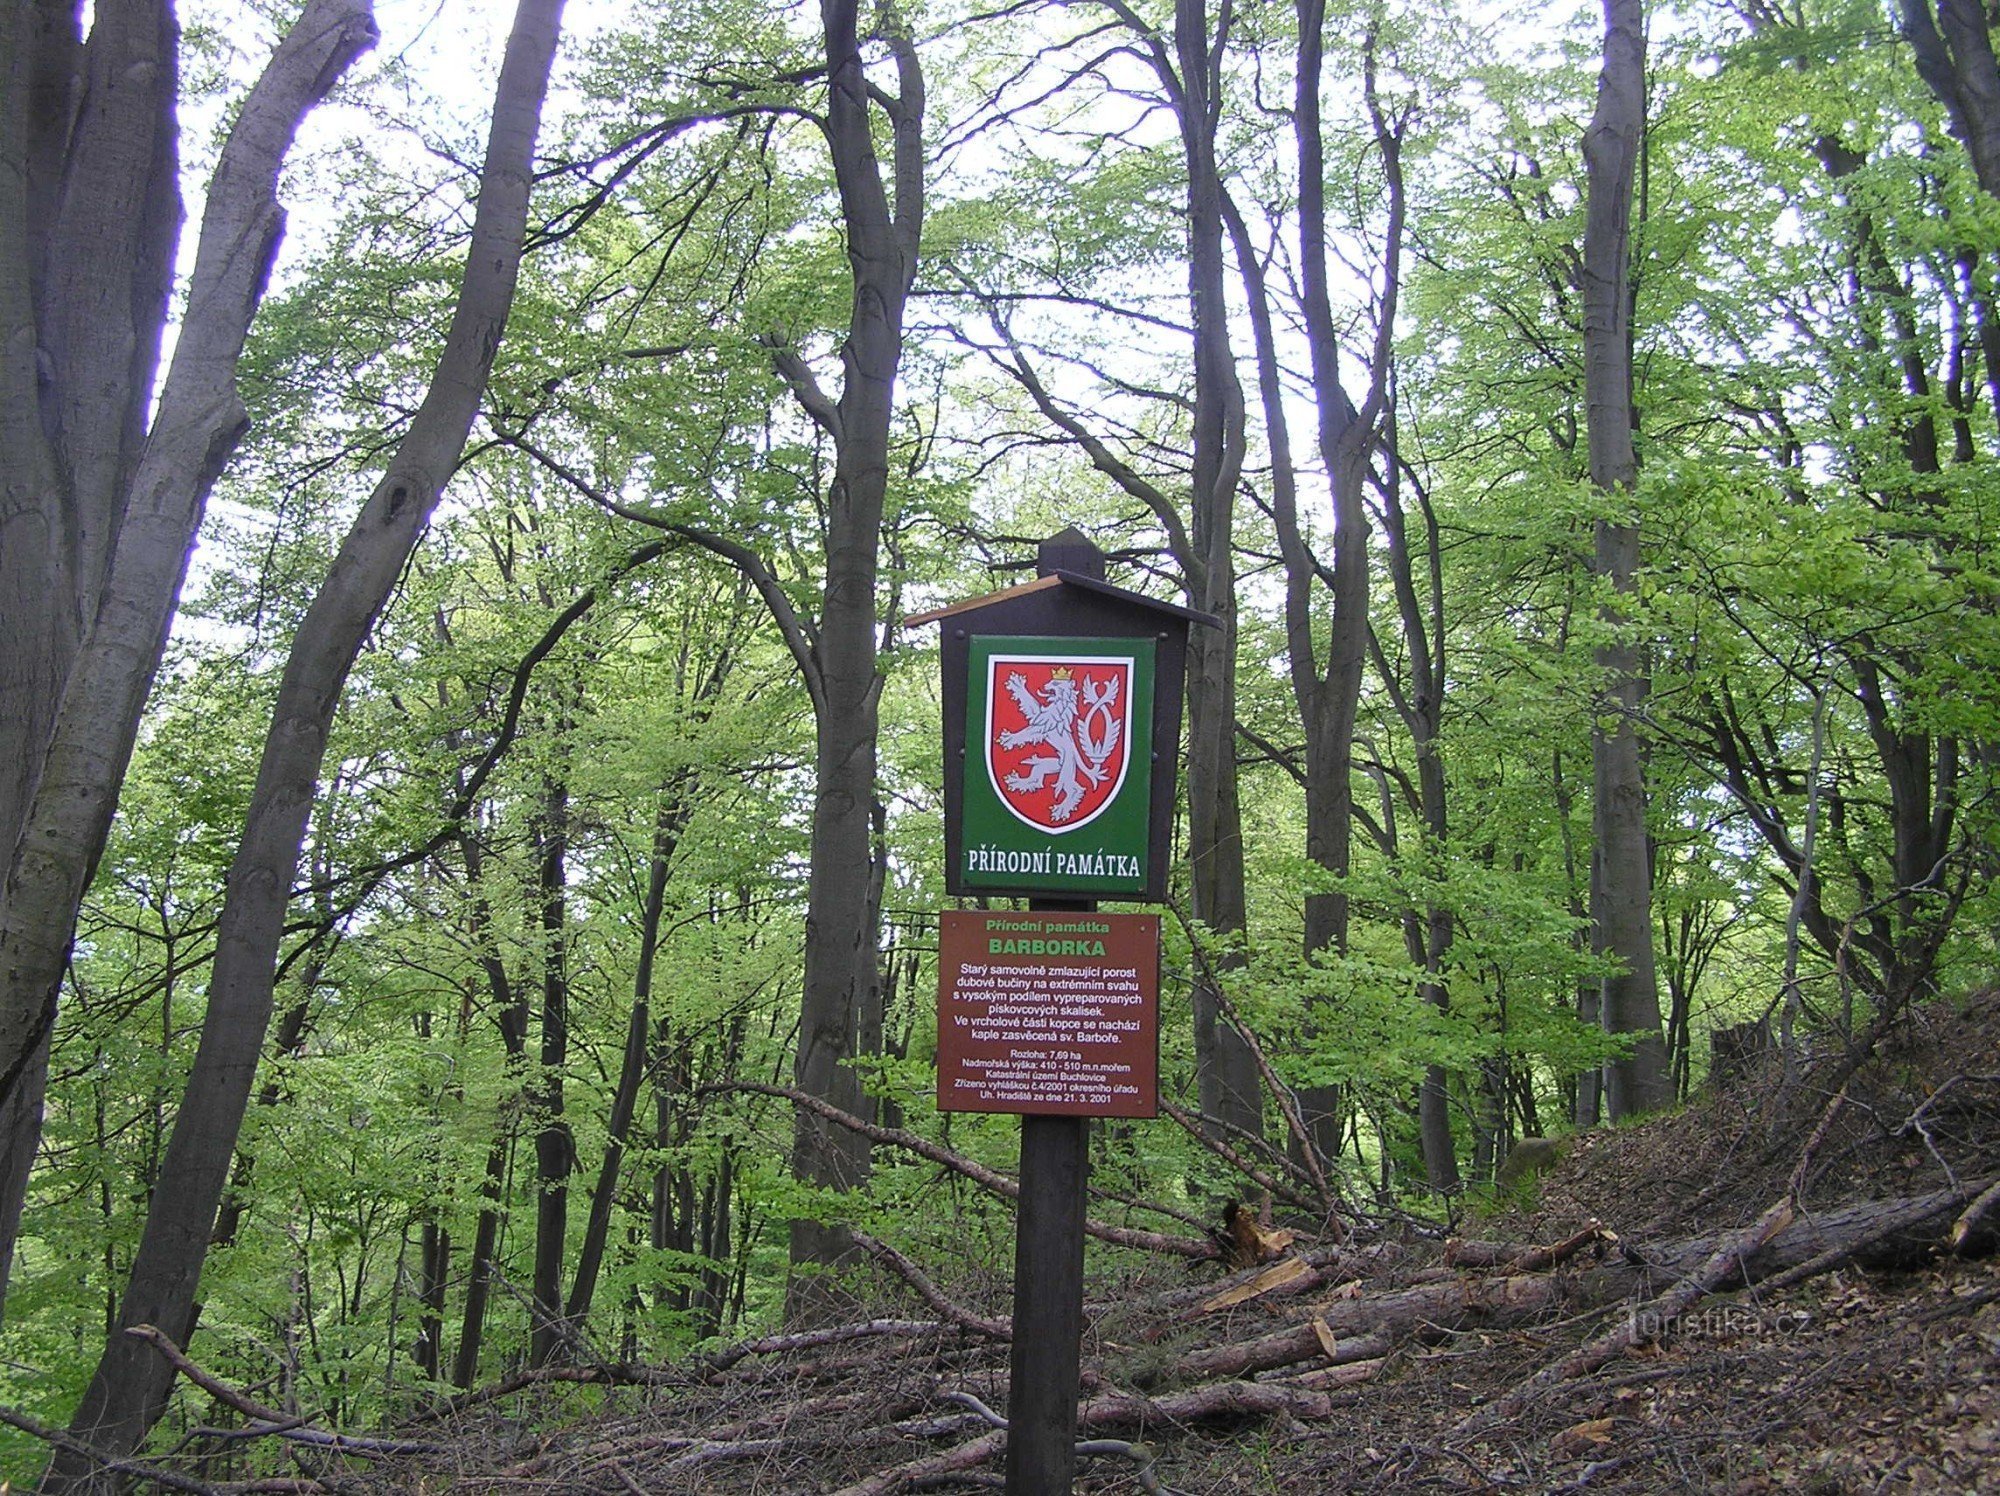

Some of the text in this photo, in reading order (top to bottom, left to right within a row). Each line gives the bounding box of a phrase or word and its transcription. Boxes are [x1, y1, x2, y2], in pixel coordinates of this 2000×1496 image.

[968, 843, 1141, 878] PŘÍRODNÍ PAMÁTKA
[986, 920, 1110, 934] Přírodní památka
[988, 938, 1106, 957] BARBORKA
[960, 963, 1136, 979] Starý samovolně zmlazující porost
[957, 977, 1139, 991] dubové bučiny na extrémním svahu
[953, 990, 1142, 1006] s vysokým podílem vypreparovaných
[988, 1003, 1106, 1017] pískovcových skalisek.
[954, 1015, 968, 1026] Ve
[971, 1016, 1020, 1027] vrcholové
[1049, 1018, 1081, 1030] kopce
[1083, 1021, 1097, 1029] se
[1098, 1019, 1140, 1031] nachází
[971, 1028, 1122, 1044] kaple zasvěcená sv. Barboře.
[1010, 1049, 1082, 1060] Rozloha: 7,69 ha
[962, 1058, 1010, 1069] Nadmořská
[1012, 1060, 1038, 1070] výška:
[1040, 1061, 1057, 1070] 410
[1064, 1062, 1081, 1071] 510
[985, 1070, 1107, 1082] Katastrální území Buchlovice
[954, 1078, 987, 1088] Zřízeno
[988, 1080, 1030, 1091] vyhláškou
[1069, 1083, 1112, 1093] okresního
[1113, 1084, 1139, 1094] úřadu
[980, 1090, 995, 1099] Uh.
[996, 1091, 1032, 1101] Hradiště
[1045, 1093, 1062, 1102] dne
[1063, 1094, 1078, 1102] 21.
[1090, 1095, 1111, 1103] 2001
